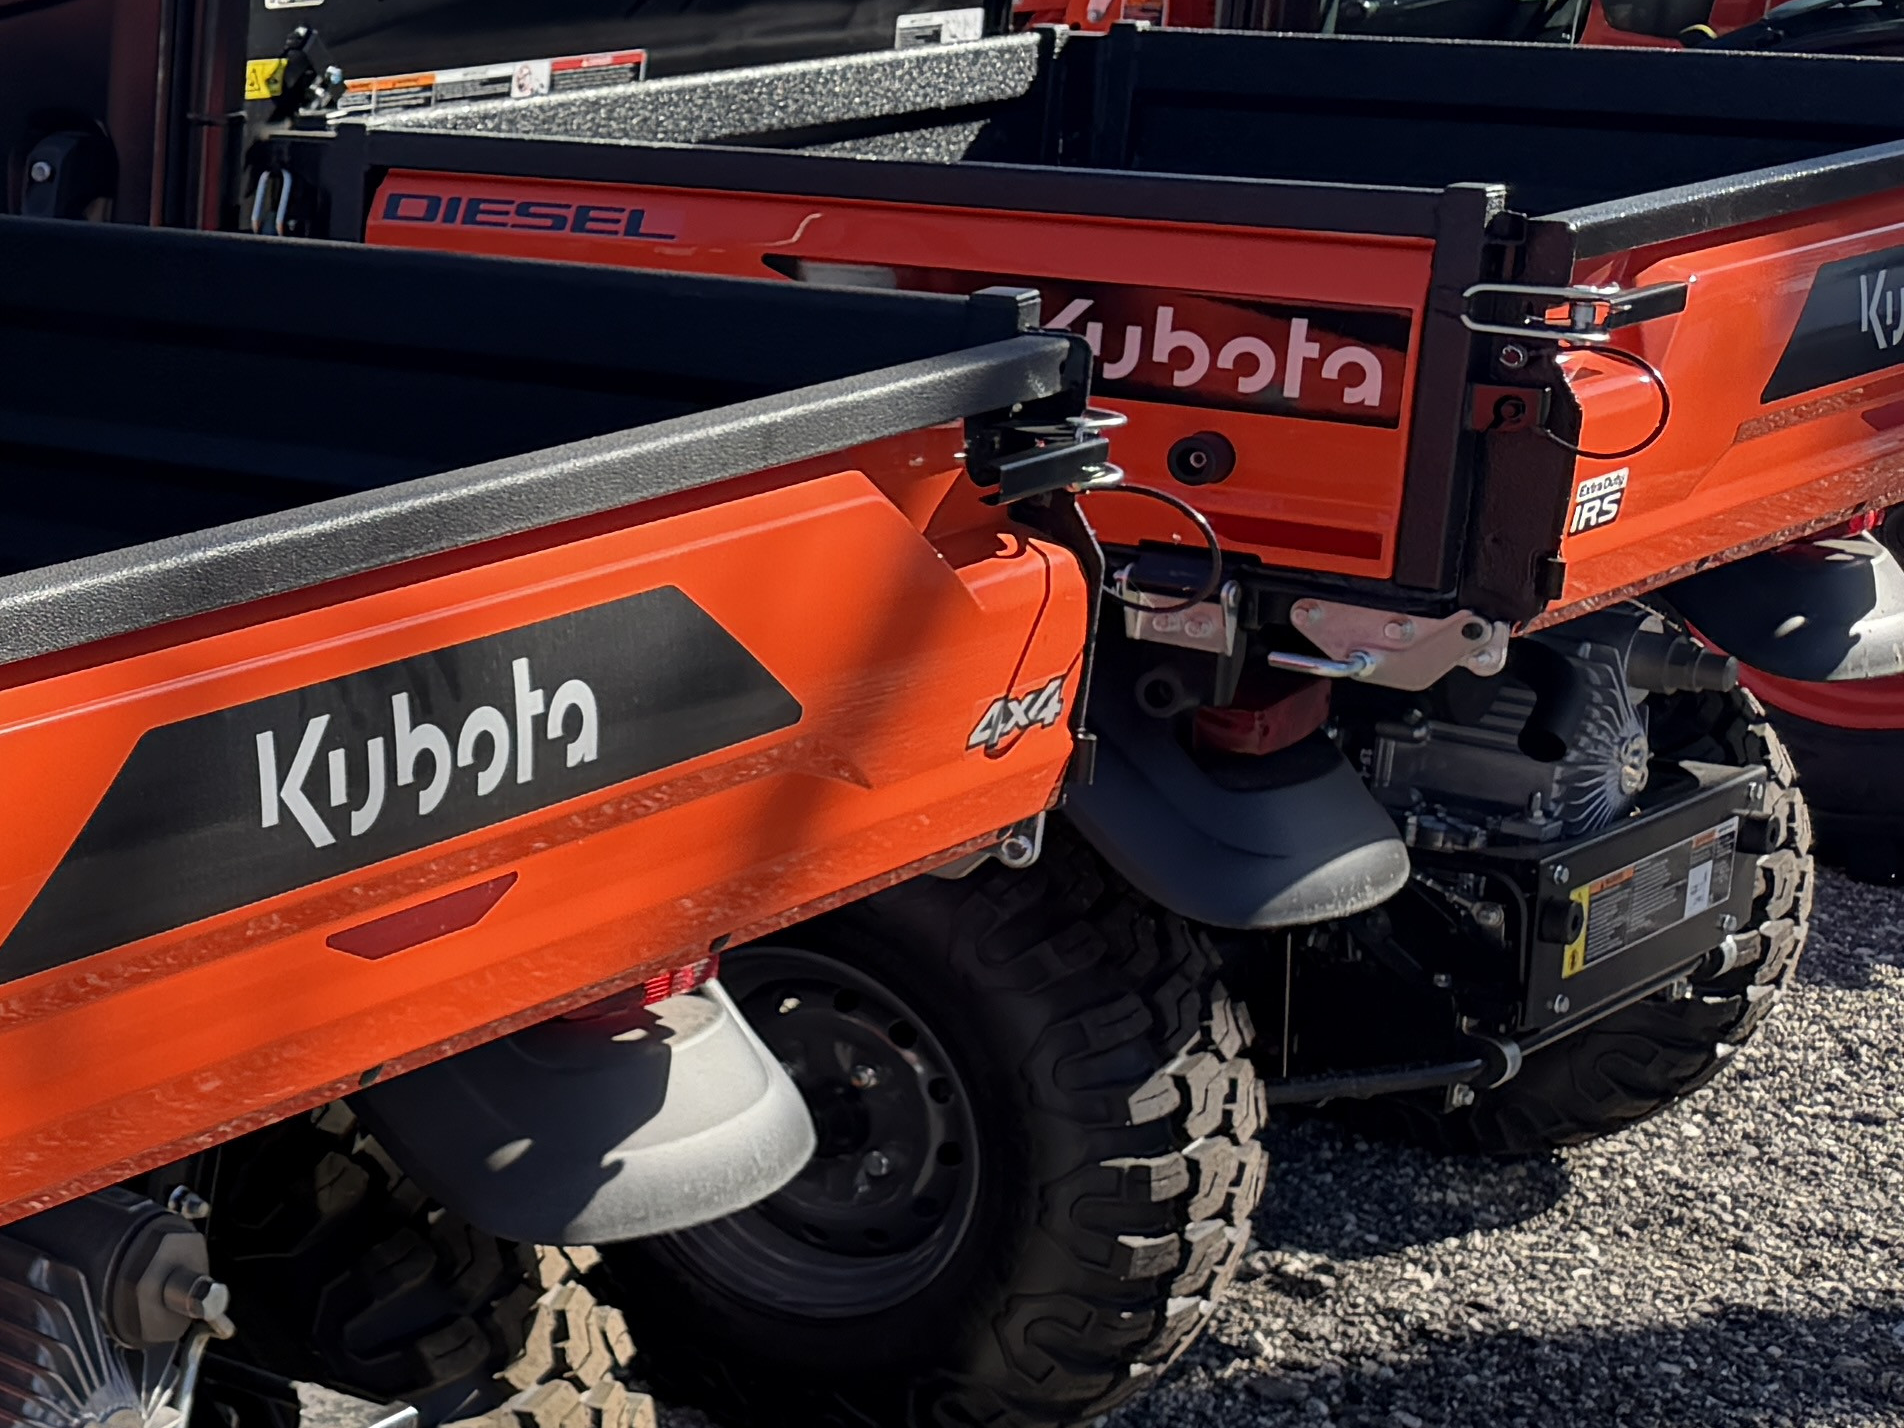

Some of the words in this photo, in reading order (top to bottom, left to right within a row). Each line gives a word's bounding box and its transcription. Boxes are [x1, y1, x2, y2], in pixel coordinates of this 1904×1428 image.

[382, 192, 676, 240] DIESEL
[1569, 491, 1622, 534] IRS
[255, 657, 598, 848] Kubota
